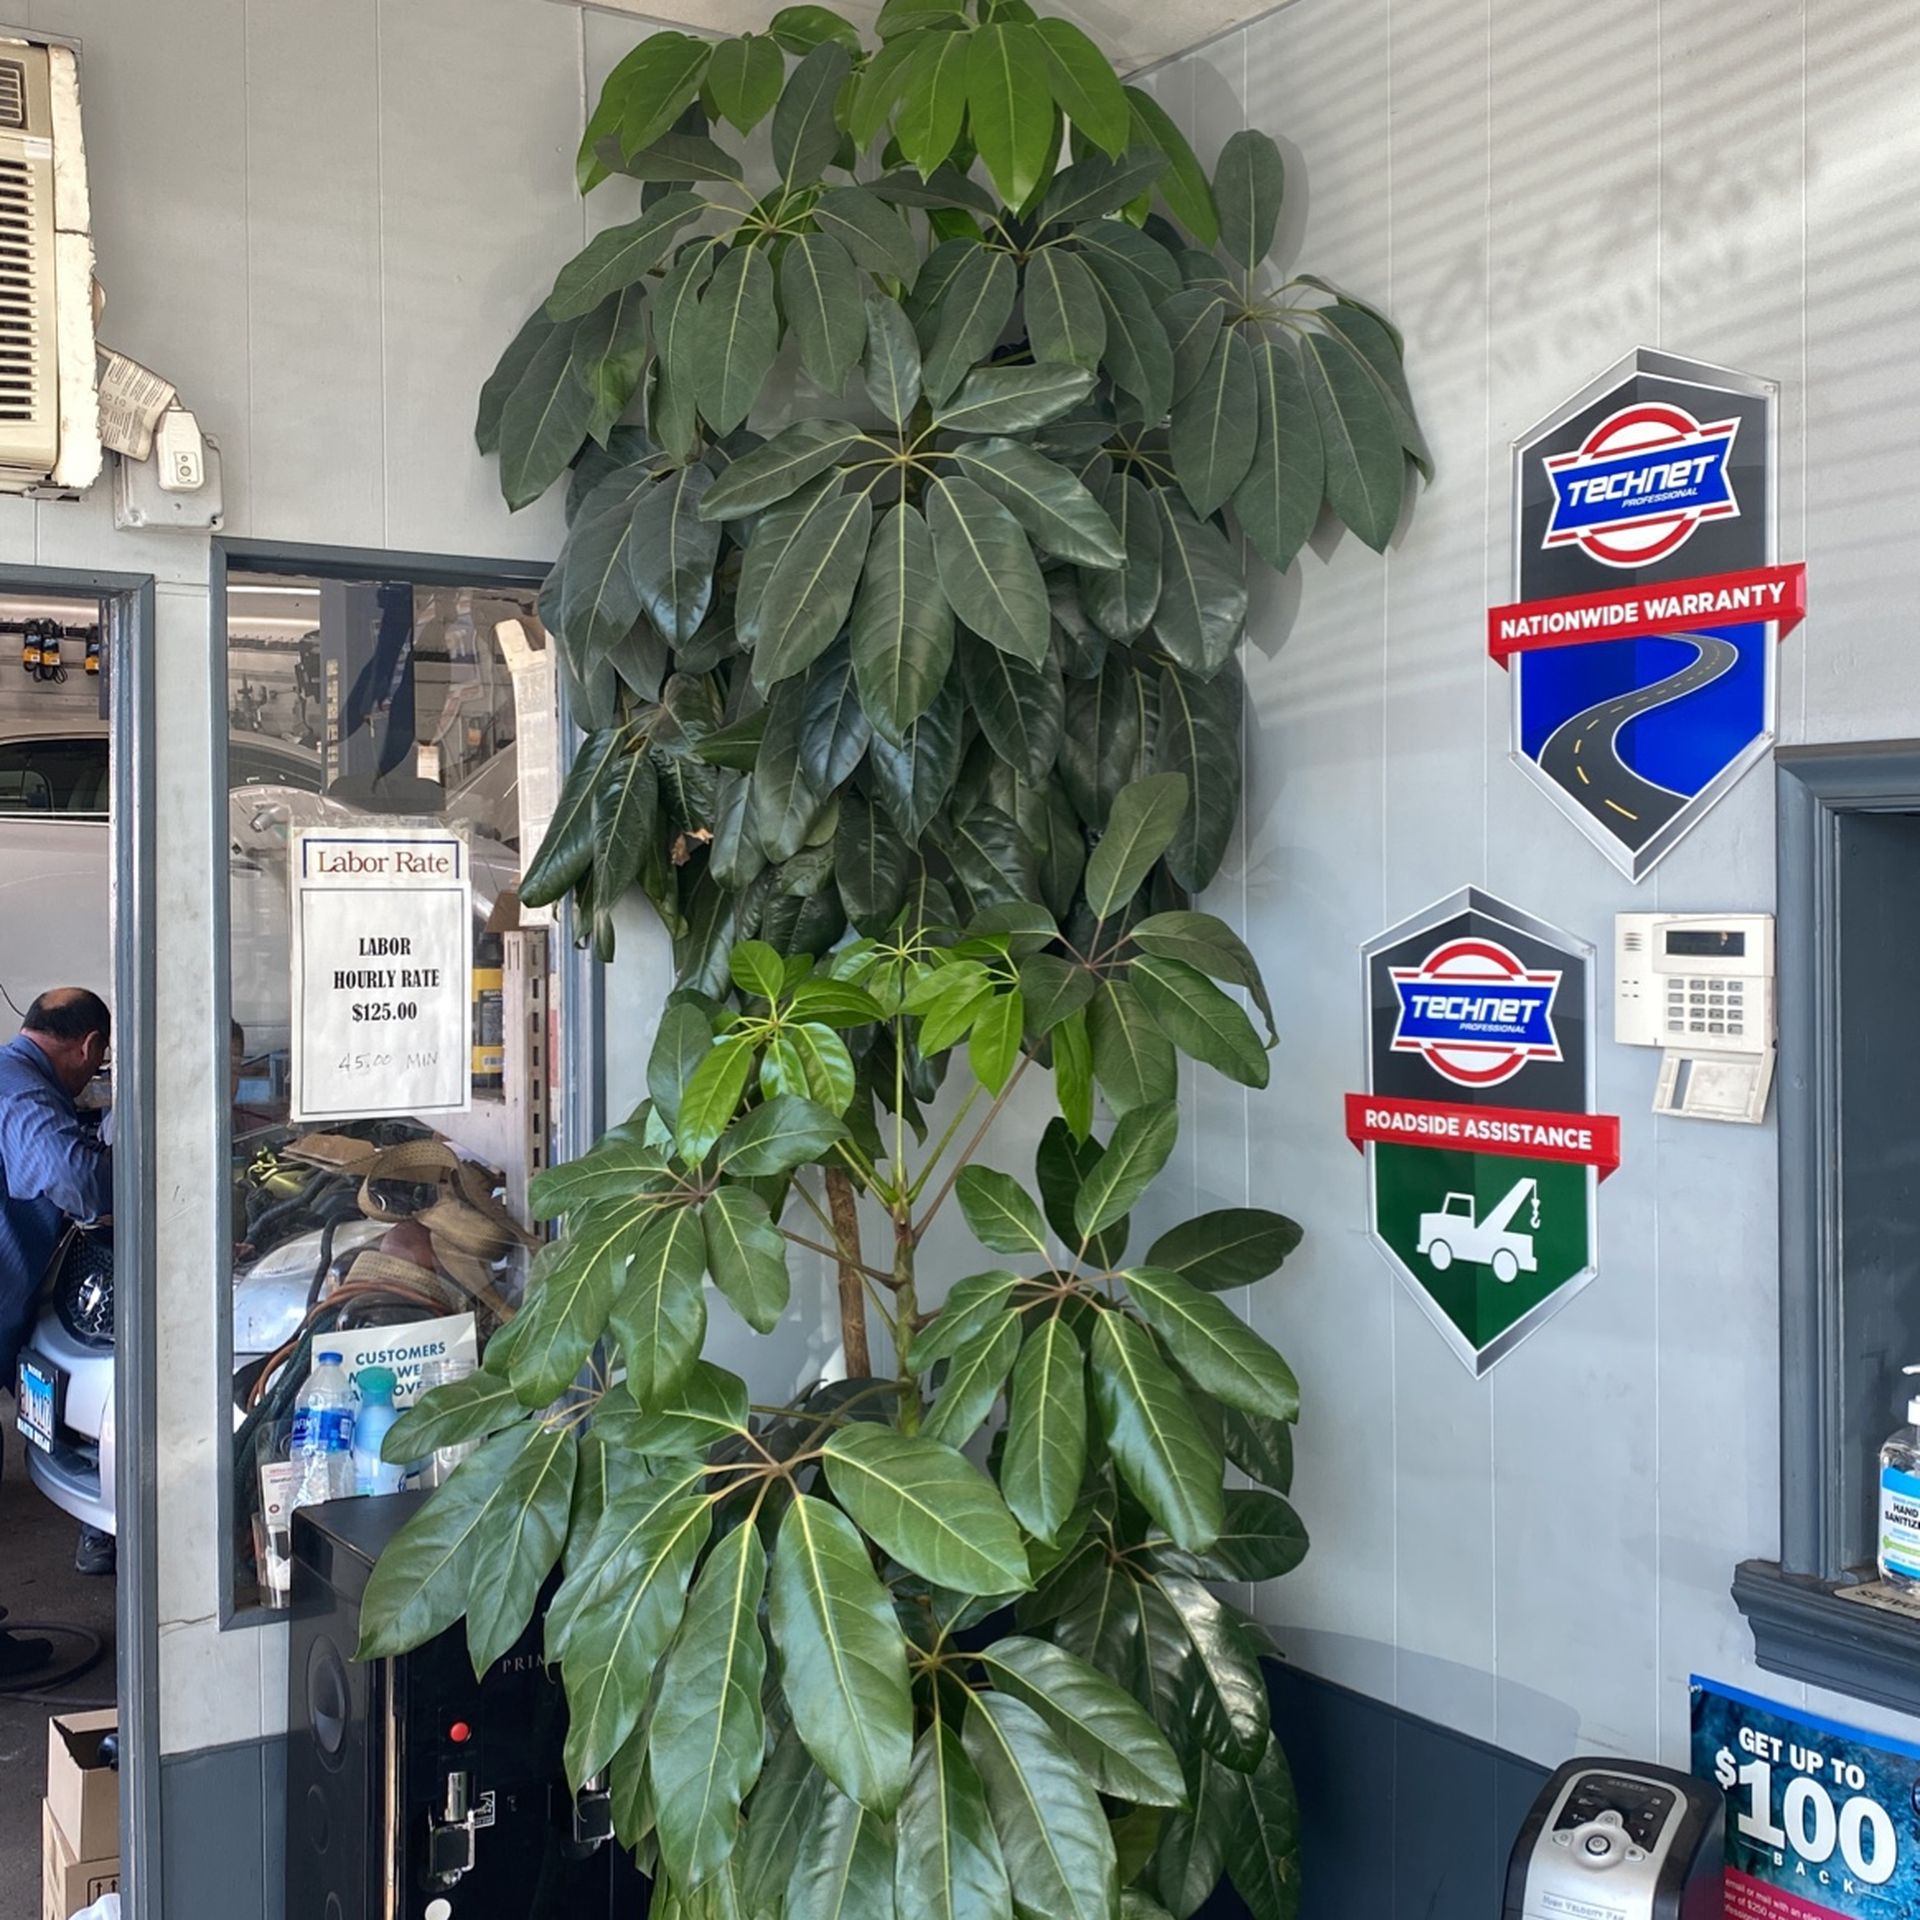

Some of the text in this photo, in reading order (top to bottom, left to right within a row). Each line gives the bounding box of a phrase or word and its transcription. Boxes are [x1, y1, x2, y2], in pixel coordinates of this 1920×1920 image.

[1621, 487, 1699, 508] PROFESSIONAL
[1500, 581, 1786, 639] NATIONWIDE WARRANTY
[318, 851, 449, 873] Labor Rate
[359, 938, 411, 956] LABOR
[333, 969, 440, 989] HOURLY RATE
[352, 1002, 417, 1022] $125.00
[1459, 1022, 1526, 1034] PROFESSIONAL
[406, 1051, 438, 1069] MIN
[1365, 1109, 1592, 1150] ROADSIDE ASSISTANCE
[355, 1341, 446, 1366] CUSTOMERS
[1893, 1502, 1919, 1518] HAND
[502, 1654, 545, 1674] PRIM
[1738, 1727, 1866, 1790] GET UP TO
[1714, 1746, 1897, 1885] $100
[1773, 1851, 1855, 1894] BACK
